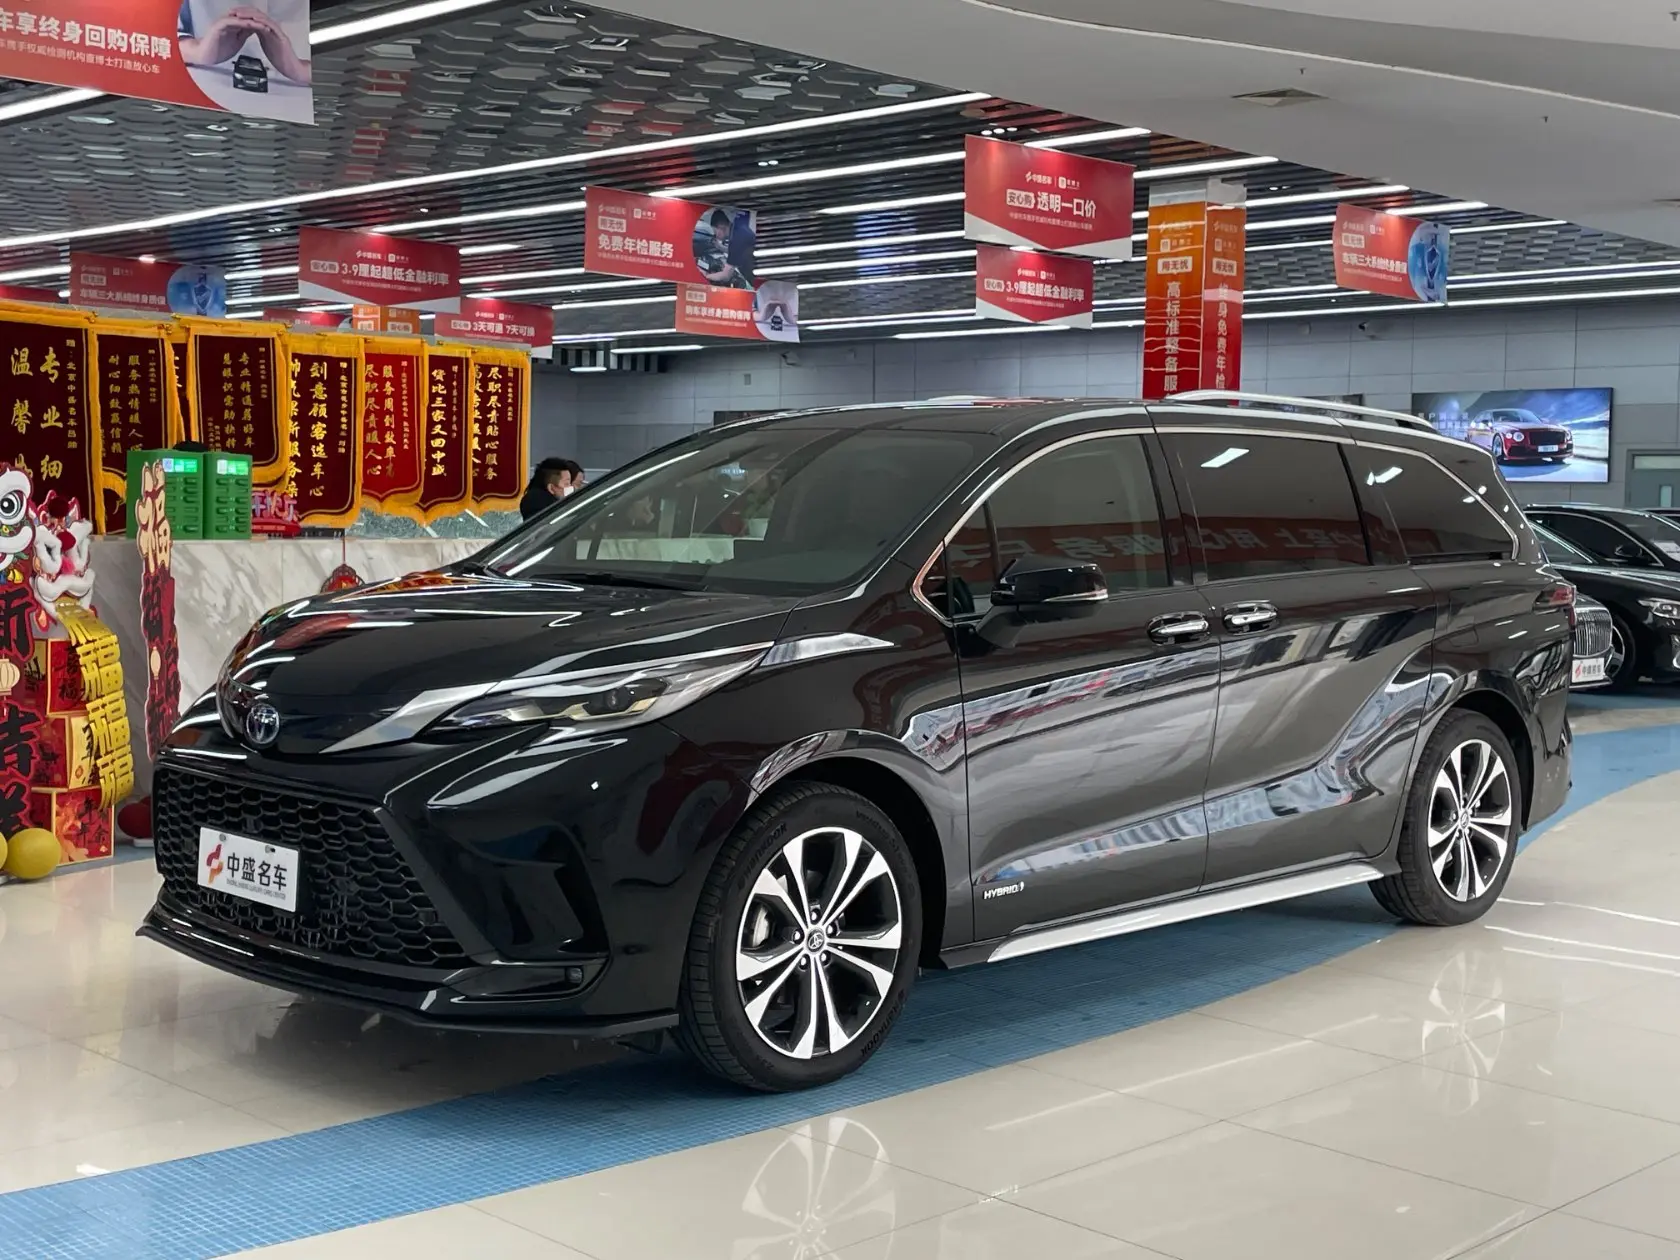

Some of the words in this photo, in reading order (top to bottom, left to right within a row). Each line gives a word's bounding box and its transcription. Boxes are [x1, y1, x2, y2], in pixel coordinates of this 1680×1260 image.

[1037, 191, 1097, 219] 透明一口价
[598, 233, 674, 259] 免费年检服务
[1164, 281, 1181, 397] 高标准整备服
[227, 852, 288, 891] 中盛名车
[983, 884, 1019, 900] HYBRID
